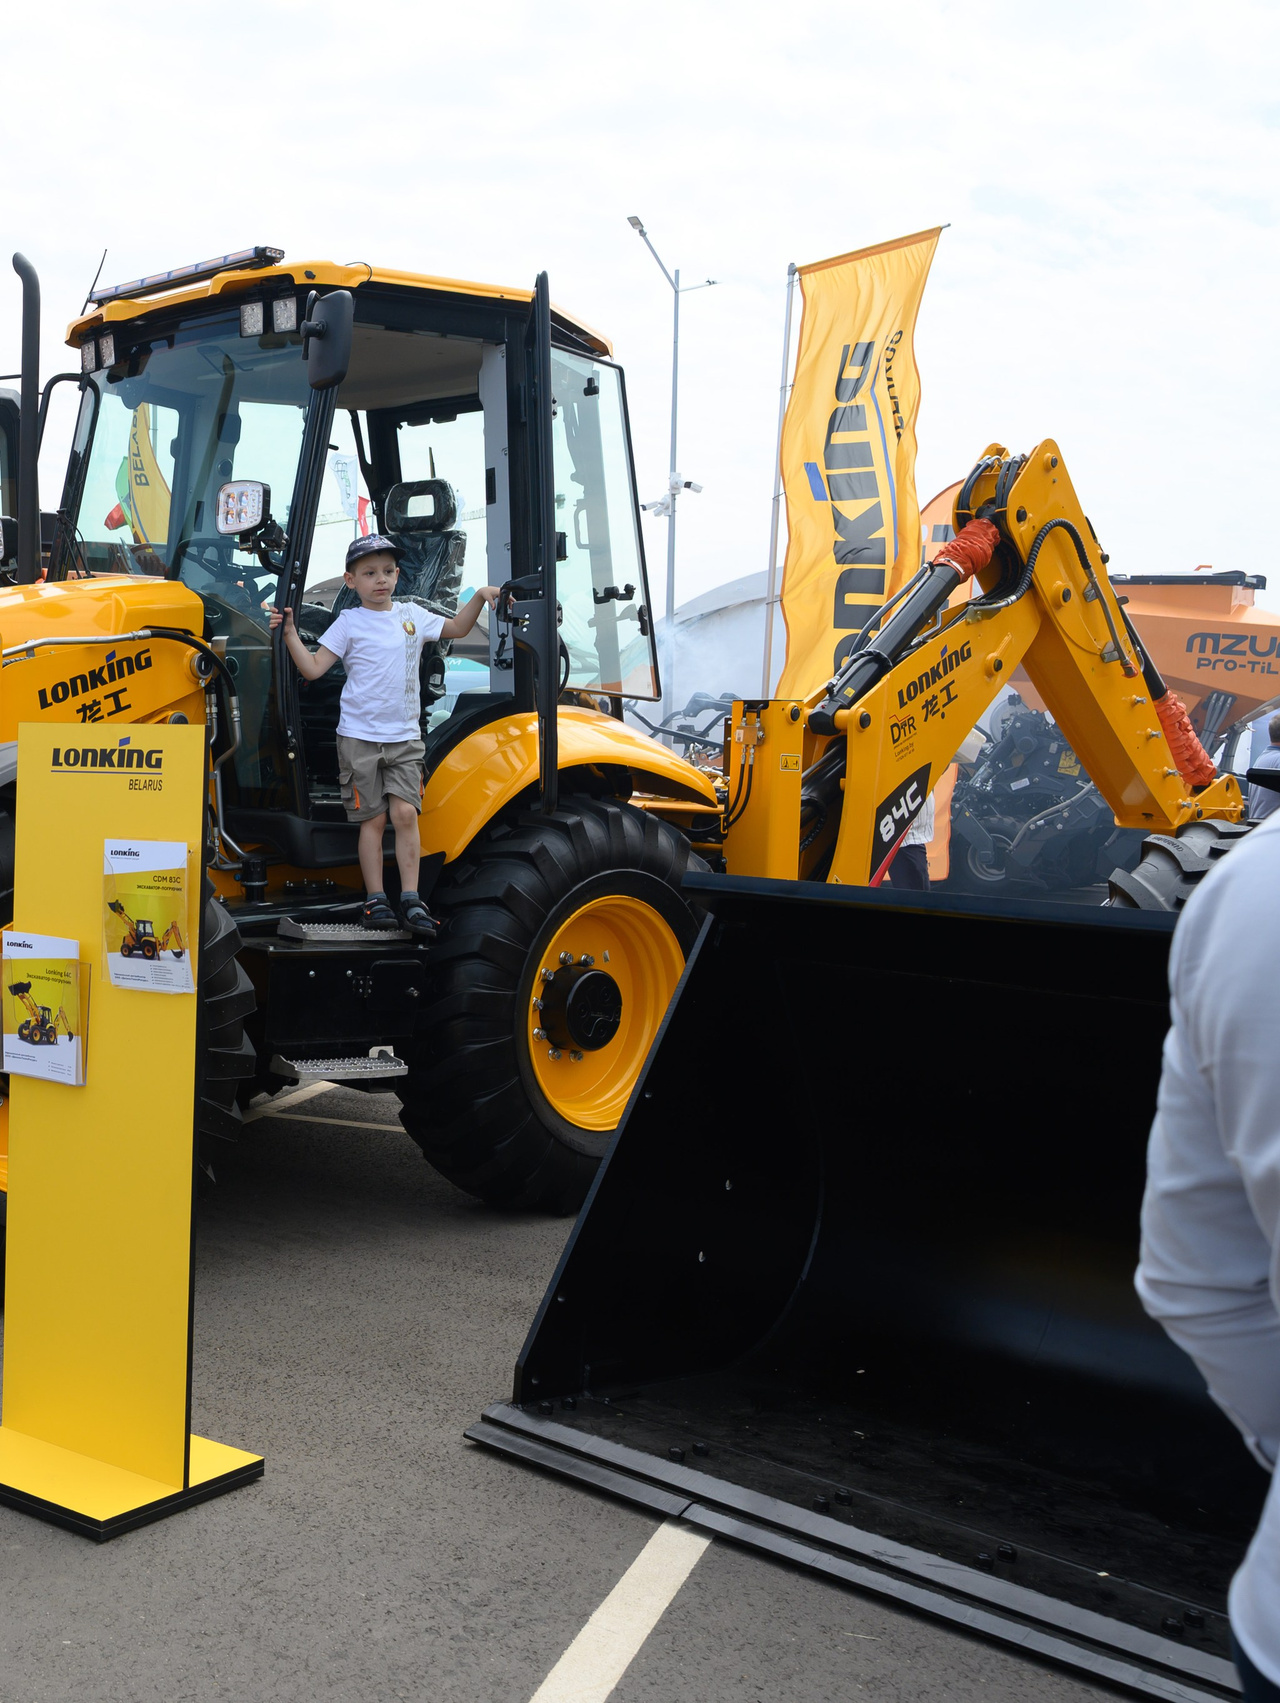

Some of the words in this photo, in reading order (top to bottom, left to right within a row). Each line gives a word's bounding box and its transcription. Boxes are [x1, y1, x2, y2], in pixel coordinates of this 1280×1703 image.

[803, 340, 886, 680] NKING
[38, 648, 153, 710] LONKING
[897, 640, 972, 710] LONKING
[921, 679, 959, 722] 龙工
[51, 736, 164, 769] LONKING
[128, 779, 163, 791] BELARUS
[880, 781, 922, 843] 84C
[152, 875, 168, 883] CDM
